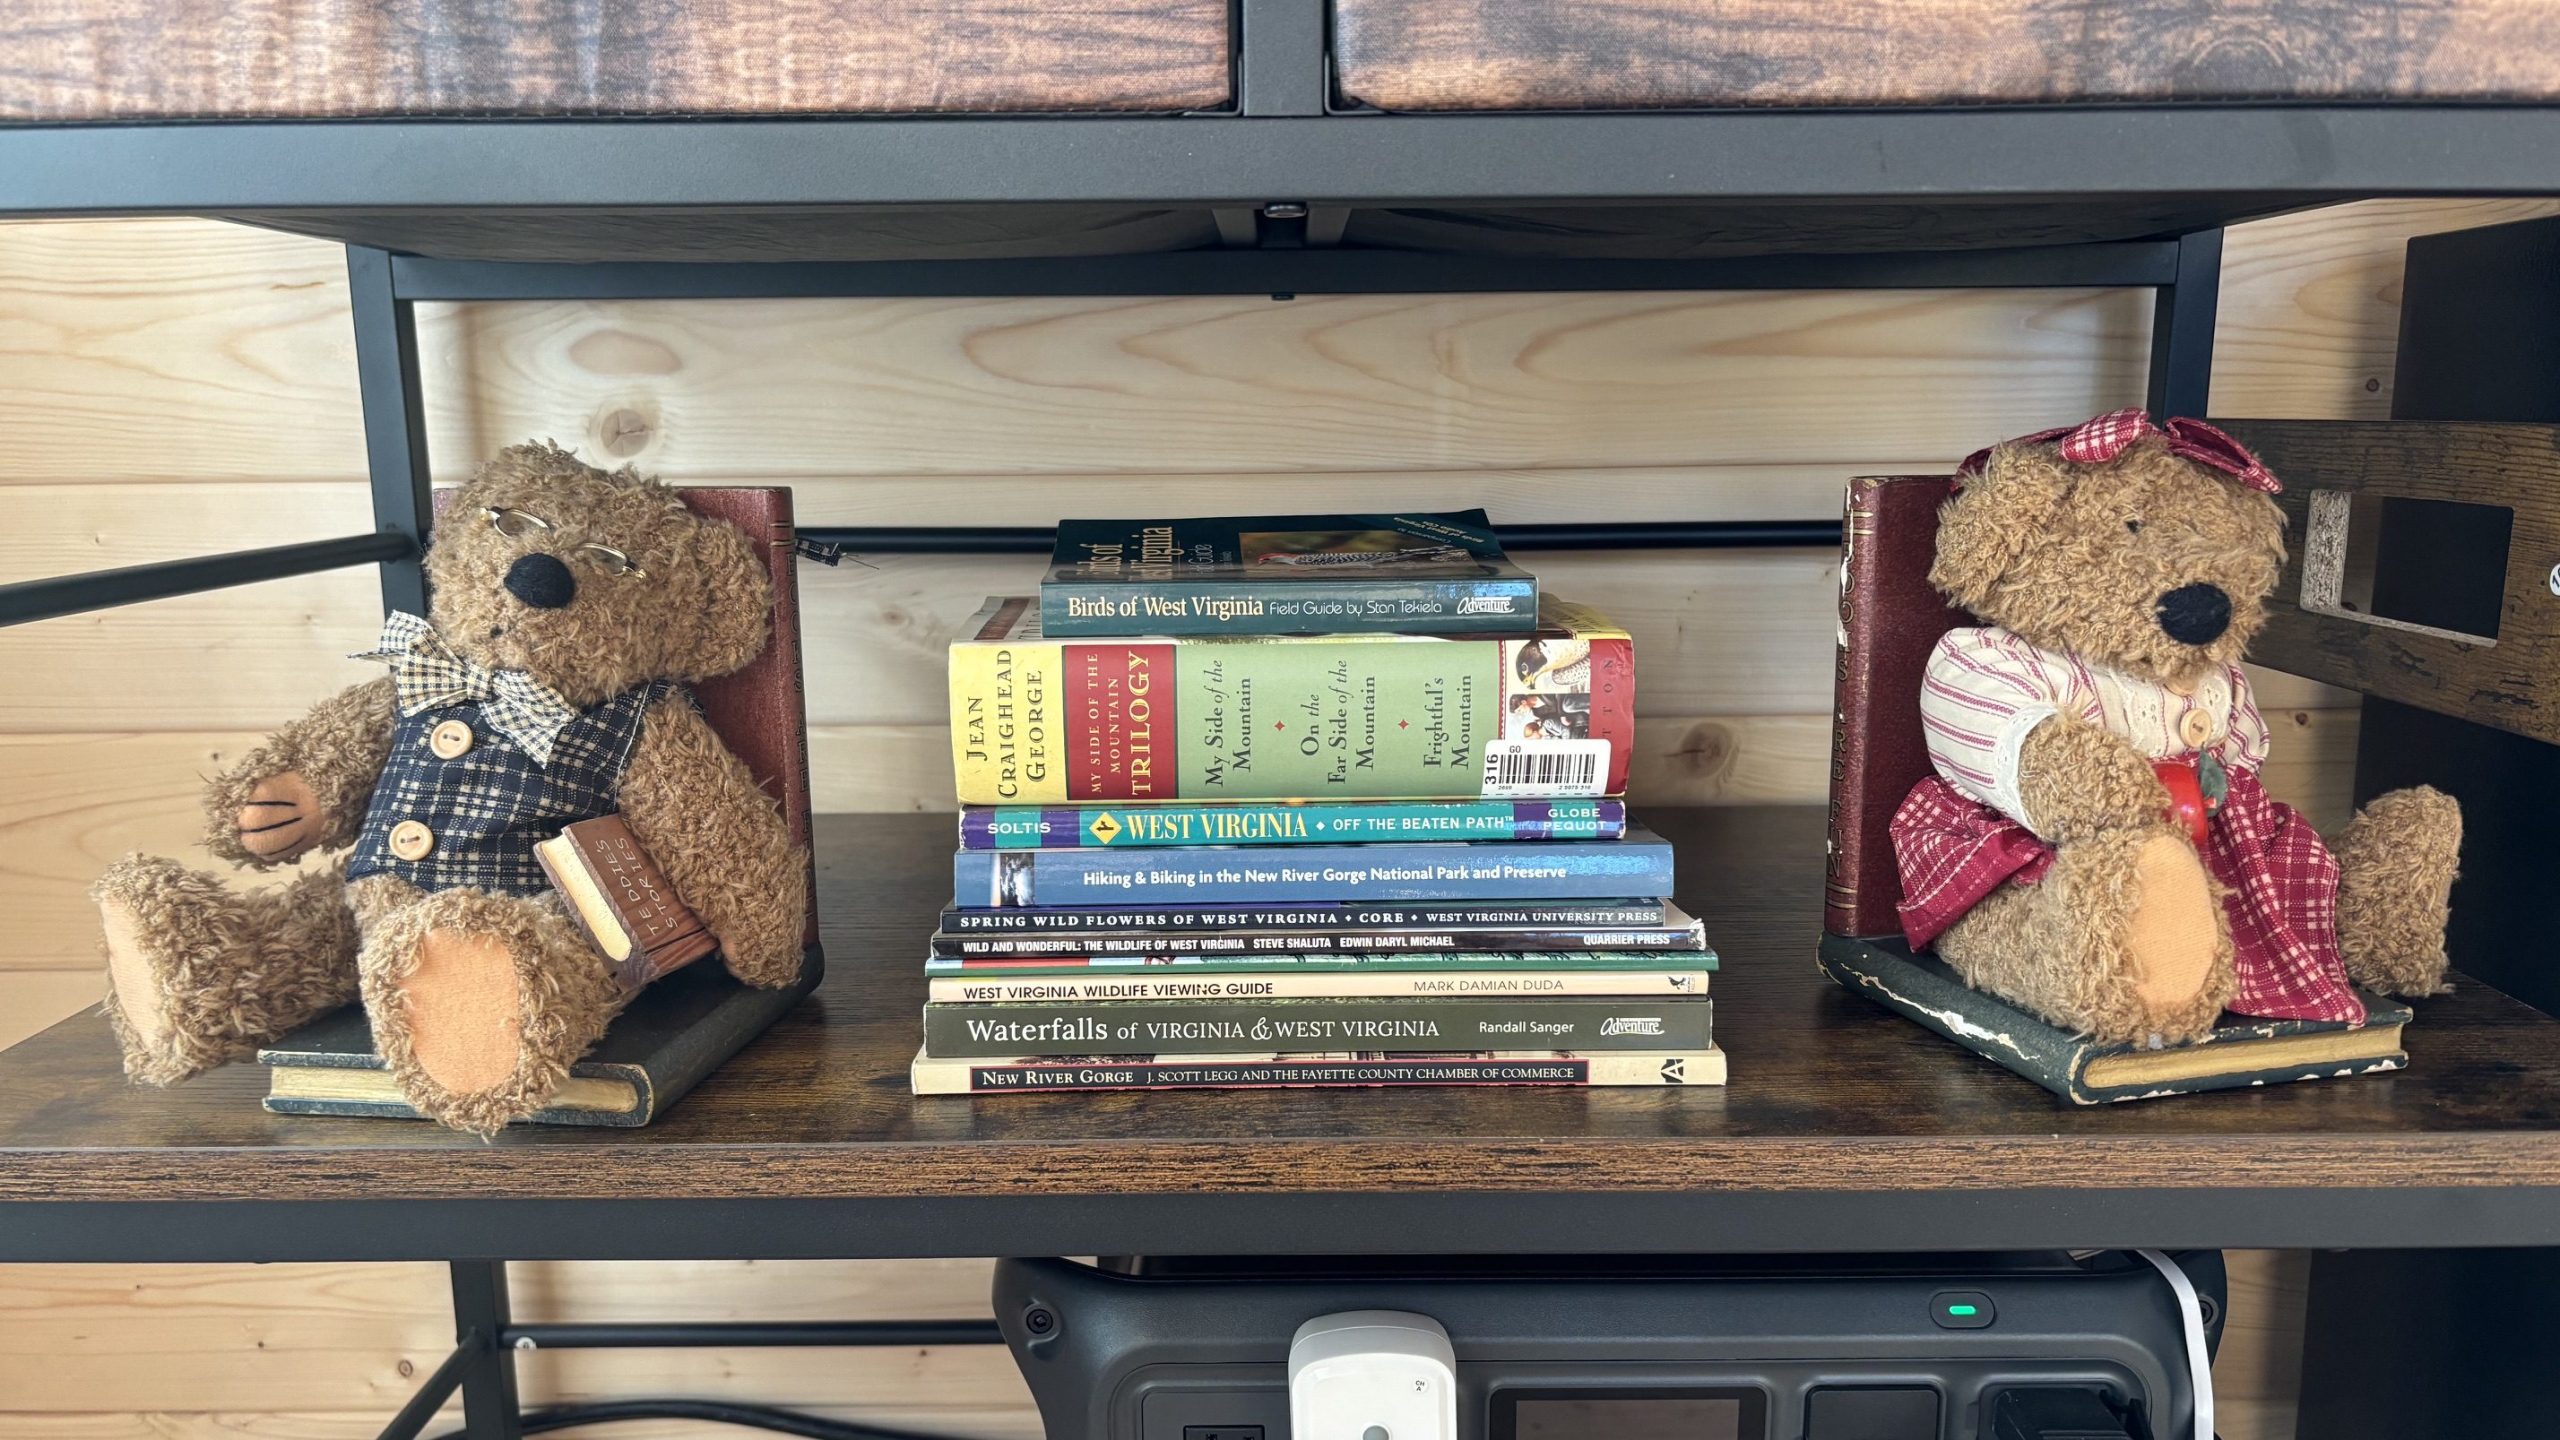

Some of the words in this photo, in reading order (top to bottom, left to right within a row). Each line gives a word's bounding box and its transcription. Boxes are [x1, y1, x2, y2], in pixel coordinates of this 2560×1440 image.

[1068, 596, 1115, 617] Birds
[1120, 596, 1140, 616] of
[1143, 597, 1188, 617] West
[1192, 596, 1264, 621] Virginia
[1270, 600, 1299, 615] Field
[1303, 600, 1343, 615] Guide
[1346, 601, 1363, 619] by
[1367, 600, 1395, 615] Stan
[1399, 599, 1442, 614] Tekiela
[1087, 653, 1099, 689] THE
[1204, 660, 1223, 684] the
[1328, 660, 1347, 683] the
[1089, 698, 1099, 719] OF
[1204, 686, 1229, 704] of
[1300, 694, 1320, 716] the
[1328, 686, 1354, 704] of
[967, 697, 987, 761] JEAN
[997, 650, 1018, 798] CRAIGHEAD
[1027, 670, 1046, 782] GEORGE
[1108, 677, 1121, 774] MOUNTAIN
[1128, 651, 1151, 795] TRILOGY
[1205, 708, 1224, 749] Side
[1233, 677, 1251, 772] Mountain
[1328, 709, 1347, 750] Side
[1355, 676, 1375, 771] Mountain
[1423, 677, 1449, 768] Frightful's
[1451, 675, 1471, 770] Mountain
[1090, 721, 1101, 765] SIDE
[1300, 725, 1320, 756] On
[1509, 745, 1522, 753] GO
[1832, 703, 1848, 782] ARE
[1205, 757, 1230, 787] My
[1328, 757, 1346, 784] Far
[1485, 753, 1498, 785] 316
[1091, 774, 1102, 792] MY
[1126, 814, 1194, 839] WEST
[1201, 813, 1308, 839] VIRGINIA
[1333, 819, 1359, 831] OFF
[1367, 818, 1395, 831] THE
[1402, 817, 1461, 830] BEATEN
[1543, 821, 1606, 831] PEQUOT
[1548, 808, 1601, 818] GLOBE
[988, 822, 1051, 834] SOLTIS
[1827, 799, 1844, 878] FUN
[615, 838, 678, 928] STORIES
[1084, 872, 1131, 888] Hiking
[1135, 873, 1146, 884] &
[1151, 871, 1196, 888] Biking
[1199, 872, 1213, 884] in
[1215, 871, 1241, 883] the
[1245, 871, 1278, 882] New
[1281, 869, 1320, 882] River
[1323, 868, 1367, 886] Gorge
[1370, 867, 1433, 880] National
[1437, 866, 1468, 879] Park
[1472, 866, 1500, 879] and
[1505, 866, 1566, 879] Preserve
[960, 916, 1026, 927] SPRING
[1033, 915, 1079, 926] WILD
[1086, 914, 1167, 925] FLOWERS
[1173, 914, 1194, 925] OF
[1201, 913, 1249, 924] WEST
[1255, 913, 1337, 924] VIRGINIA
[1359, 912, 1404, 923] CORE
[1427, 912, 1464, 922] WEST
[1467, 912, 1529, 922] VIRGINIA
[1532, 912, 1614, 922] UNIVERSITY
[1618, 911, 1658, 921] PRESS
[963, 942, 989, 952] WILD
[992, 942, 1014, 952] AND
[1016, 941, 1082, 952] WONDERFUL:
[1084, 941, 1103, 951] THE
[1106, 940, 1152, 951] WILDLIFE
[1155, 940, 1167, 950] OF
[1170, 940, 1197, 950] WEST
[1200, 939, 1245, 950] VIRGINIA
[1253, 939, 1284, 949] STEVE
[1286, 938, 1332, 949] SHALUTA
[1340, 936, 1373, 947] EDWIN
[1375, 936, 1408, 947] DARYL
[1410, 935, 1455, 947] MICHAEL
[1584, 934, 1635, 946] QUARRIER
[1637, 934, 1670, 945] PRESS
[963, 988, 1001, 999] WEST
[1007, 986, 1078, 999] VIRGINIA
[1083, 985, 1148, 998] WILDLIFE
[1153, 983, 1220, 996] VIEWING
[1226, 982, 1273, 995] GUIDE
[1413, 981, 1455, 991] MARK
[1460, 980, 1518, 991] DAMIAN
[1523, 979, 1564, 990] DUDA
[966, 1017, 1108, 1042] Waterfalls
[1117, 1021, 1137, 1040] of
[1146, 1022, 1245, 1039] VIRGINIA
[1251, 1017, 1273, 1041] &
[1274, 1020, 1335, 1038] WEST
[1342, 1020, 1439, 1037] VIRGINIA
[1479, 1020, 1526, 1033] Randall
[1529, 1021, 1574, 1036] Sanger
[1146, 1071, 1155, 1084] J.
[1158, 1071, 1200, 1082] SCOTT
[1205, 1070, 1238, 1082] LEGG
[1241, 1070, 1270, 1081] AND
[1273, 1070, 1299, 1081] THE
[1302, 1069, 1355, 1080] FAYETTE
[1358, 1069, 1414, 1080] COUNTY
[1416, 1068, 1478, 1079] CHAMBER
[1482, 1068, 1499, 1079] OF
[1501, 1067, 1574, 1079] COMMERCE
